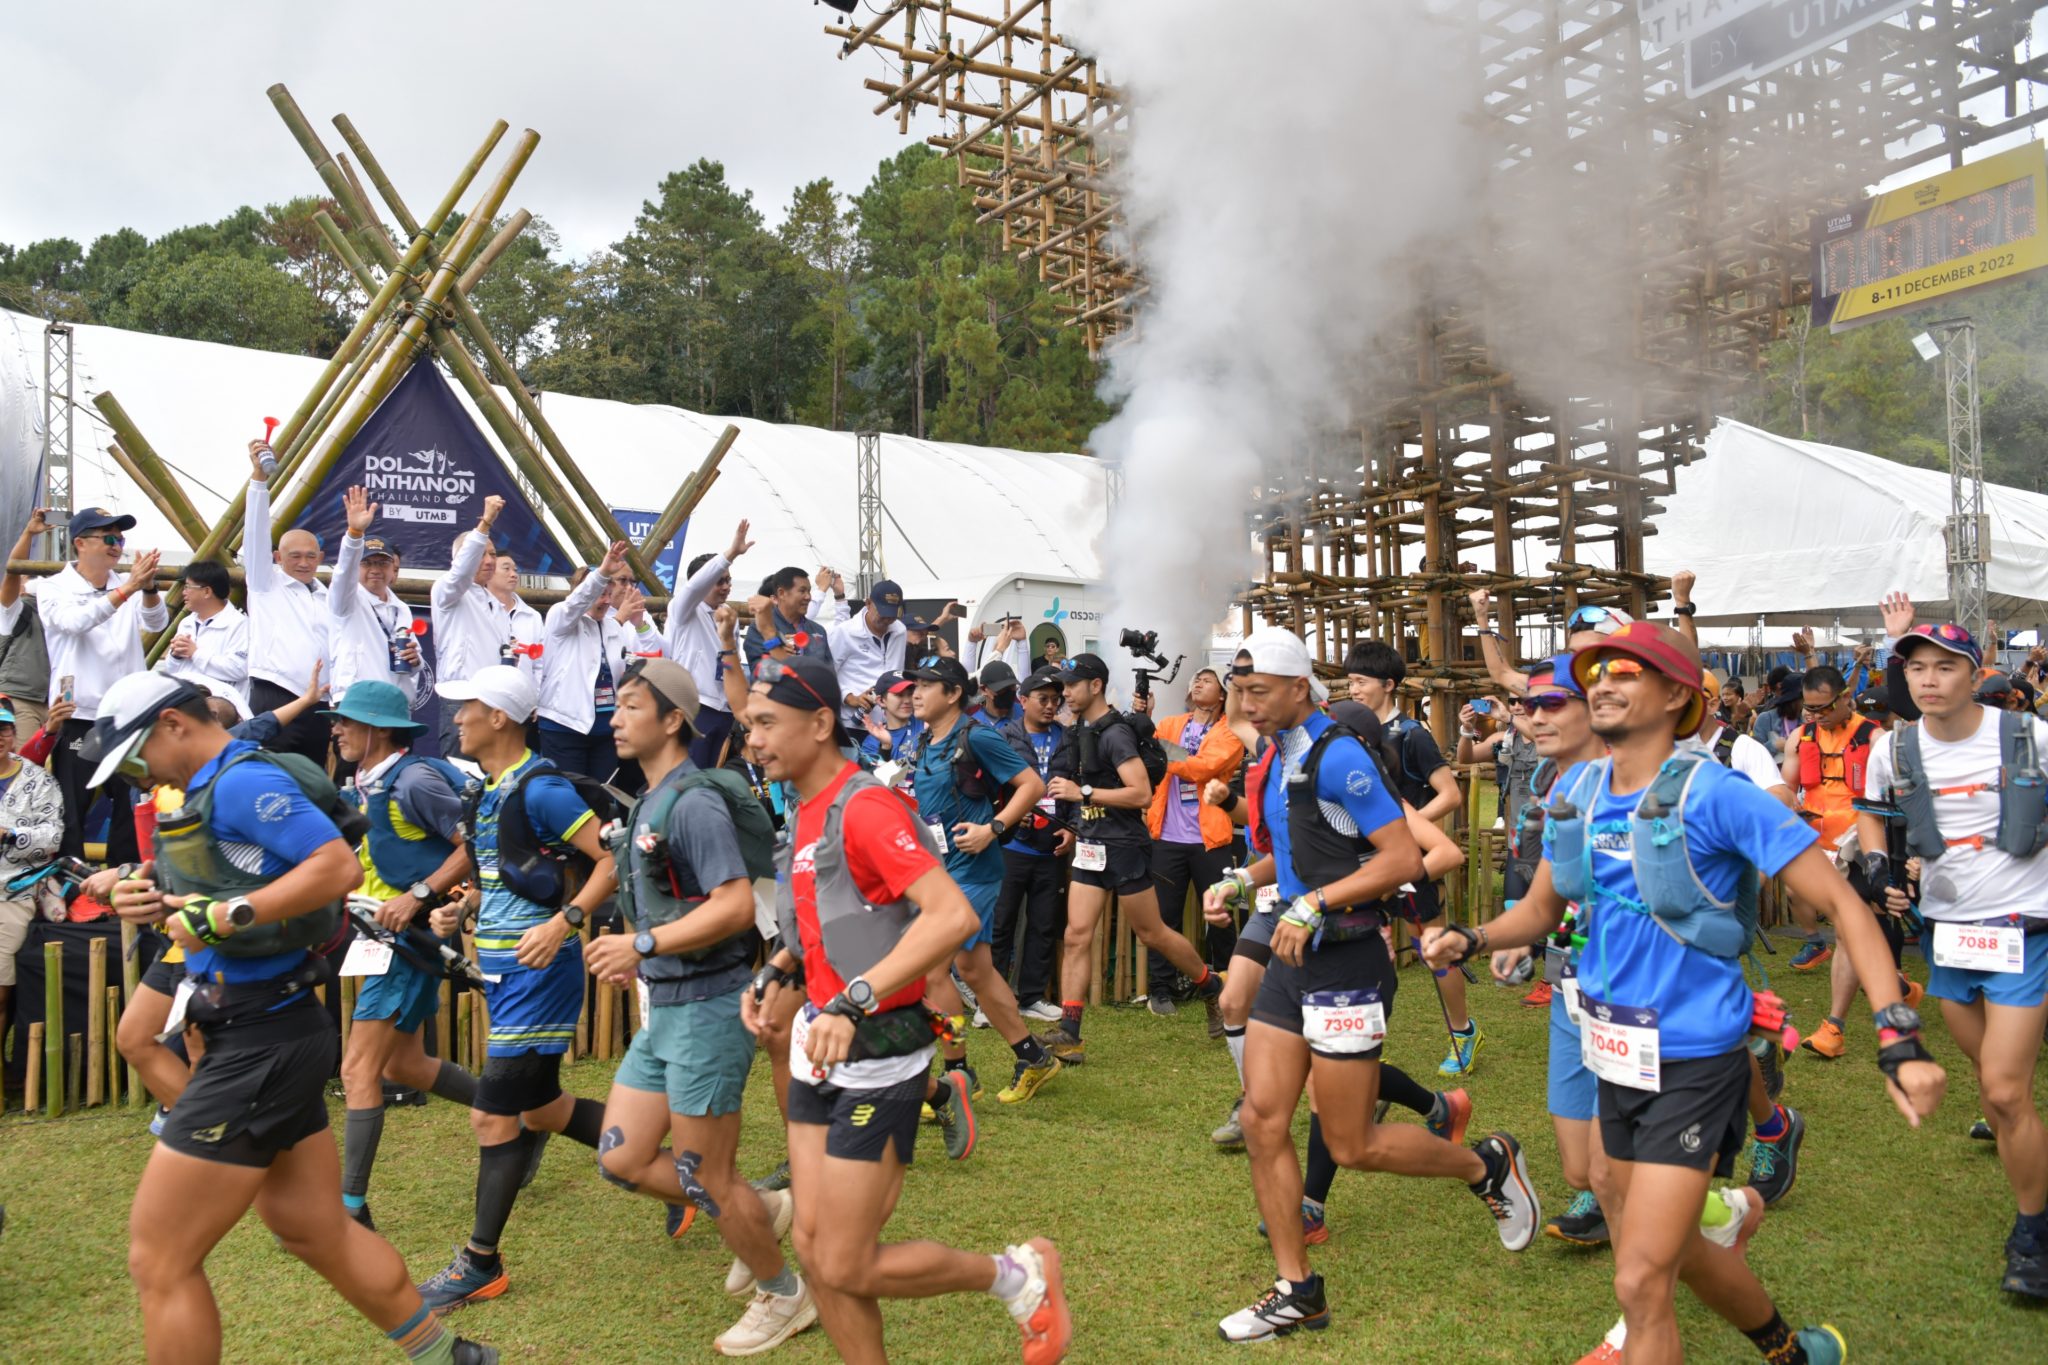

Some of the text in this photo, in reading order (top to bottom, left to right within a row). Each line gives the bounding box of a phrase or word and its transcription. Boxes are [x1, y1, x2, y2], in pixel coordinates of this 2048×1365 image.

[1652, 0, 1738, 42] THA
[1788, 0, 1872, 39] UTM
[1709, 30, 1743, 67] BY
[1827, 214, 1852, 227] UTMB
[1871, 254, 2014, 304] 8-11 DECEMBER 2022
[366, 455, 402, 472] DOI
[368, 491, 441, 503] THAILAND
[389, 507, 447, 521] BY UTMB
[629, 522, 654, 537] UT
[1958, 936, 1998, 949] 7088
[1325, 1018, 1364, 1031] 7390
[1591, 1031, 1629, 1056] 7040
